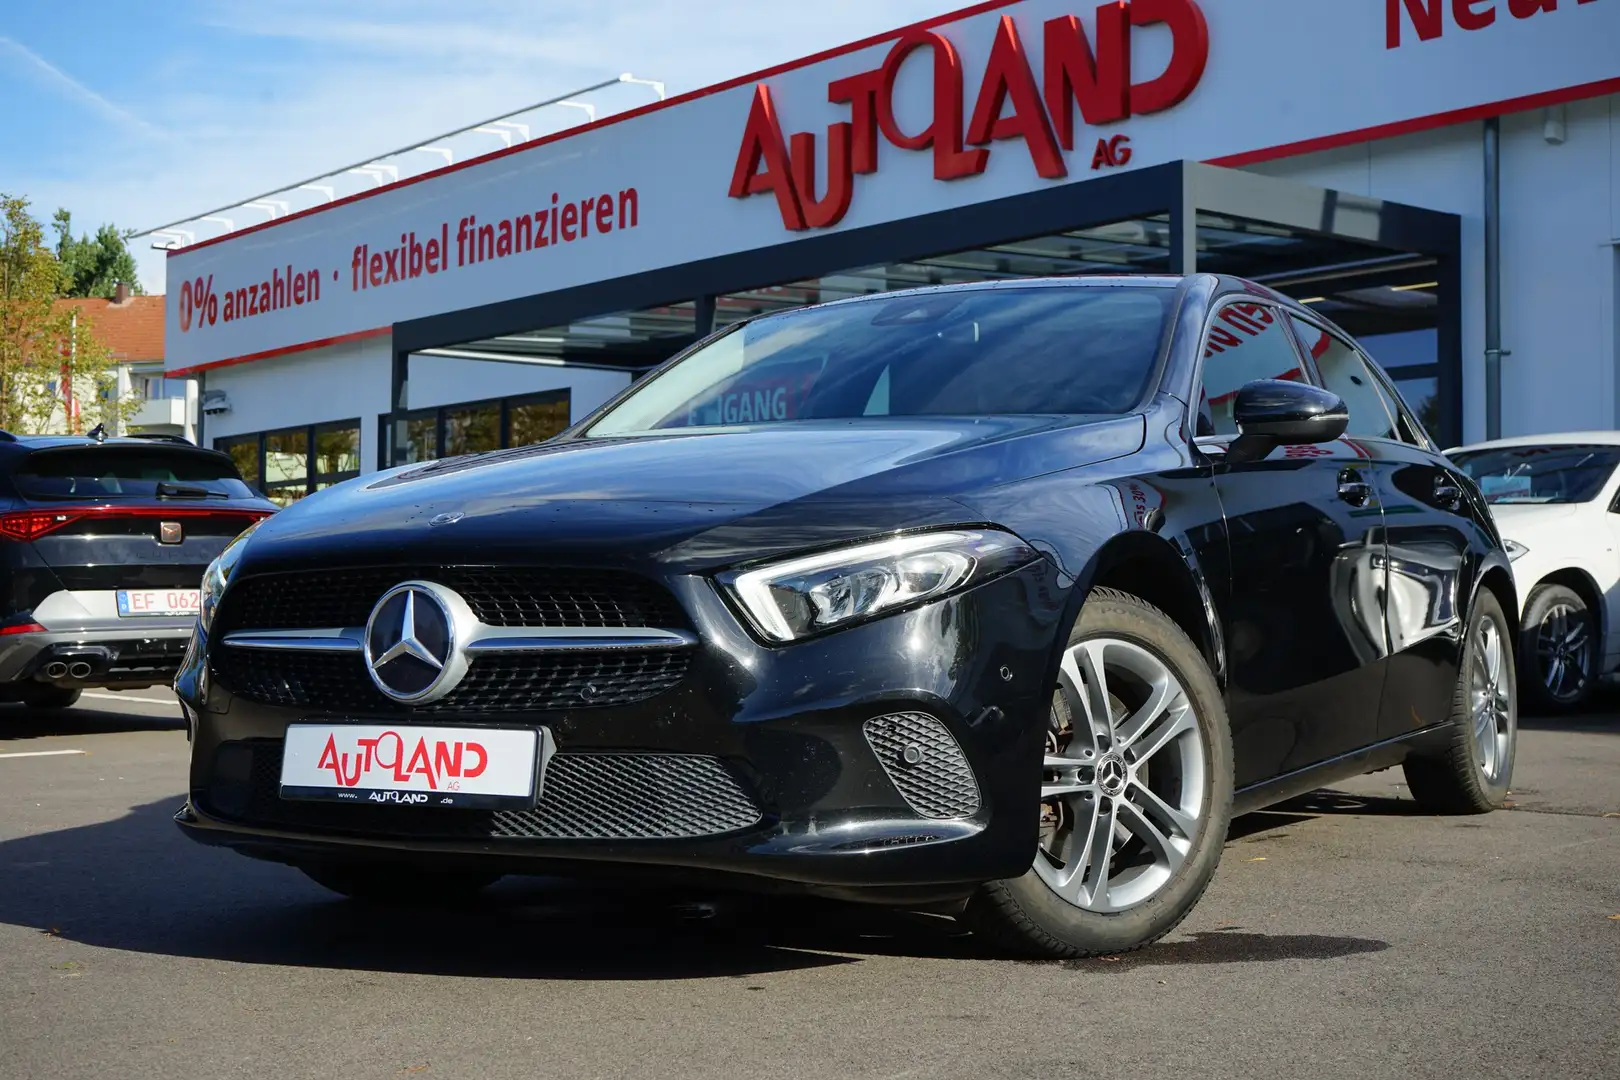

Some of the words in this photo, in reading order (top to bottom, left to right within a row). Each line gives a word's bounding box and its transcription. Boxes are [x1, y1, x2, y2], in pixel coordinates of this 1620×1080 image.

[728, 0, 1209, 230] AUTOLAND
[1091, 134, 1132, 170] AG
[180, 273, 218, 333] 0%
[223, 264, 321, 323] anzahlen
[351, 222, 449, 292] flexibel
[457, 187, 639, 267] finanzieren
[132, 593, 155, 610] EF
[166, 592, 200, 609] 062
[317, 730, 489, 790] AUTOLAND
[368, 790, 429, 805] AUTOLAND
[440, 797, 454, 805] .de
[446, 780, 461, 792] AG
